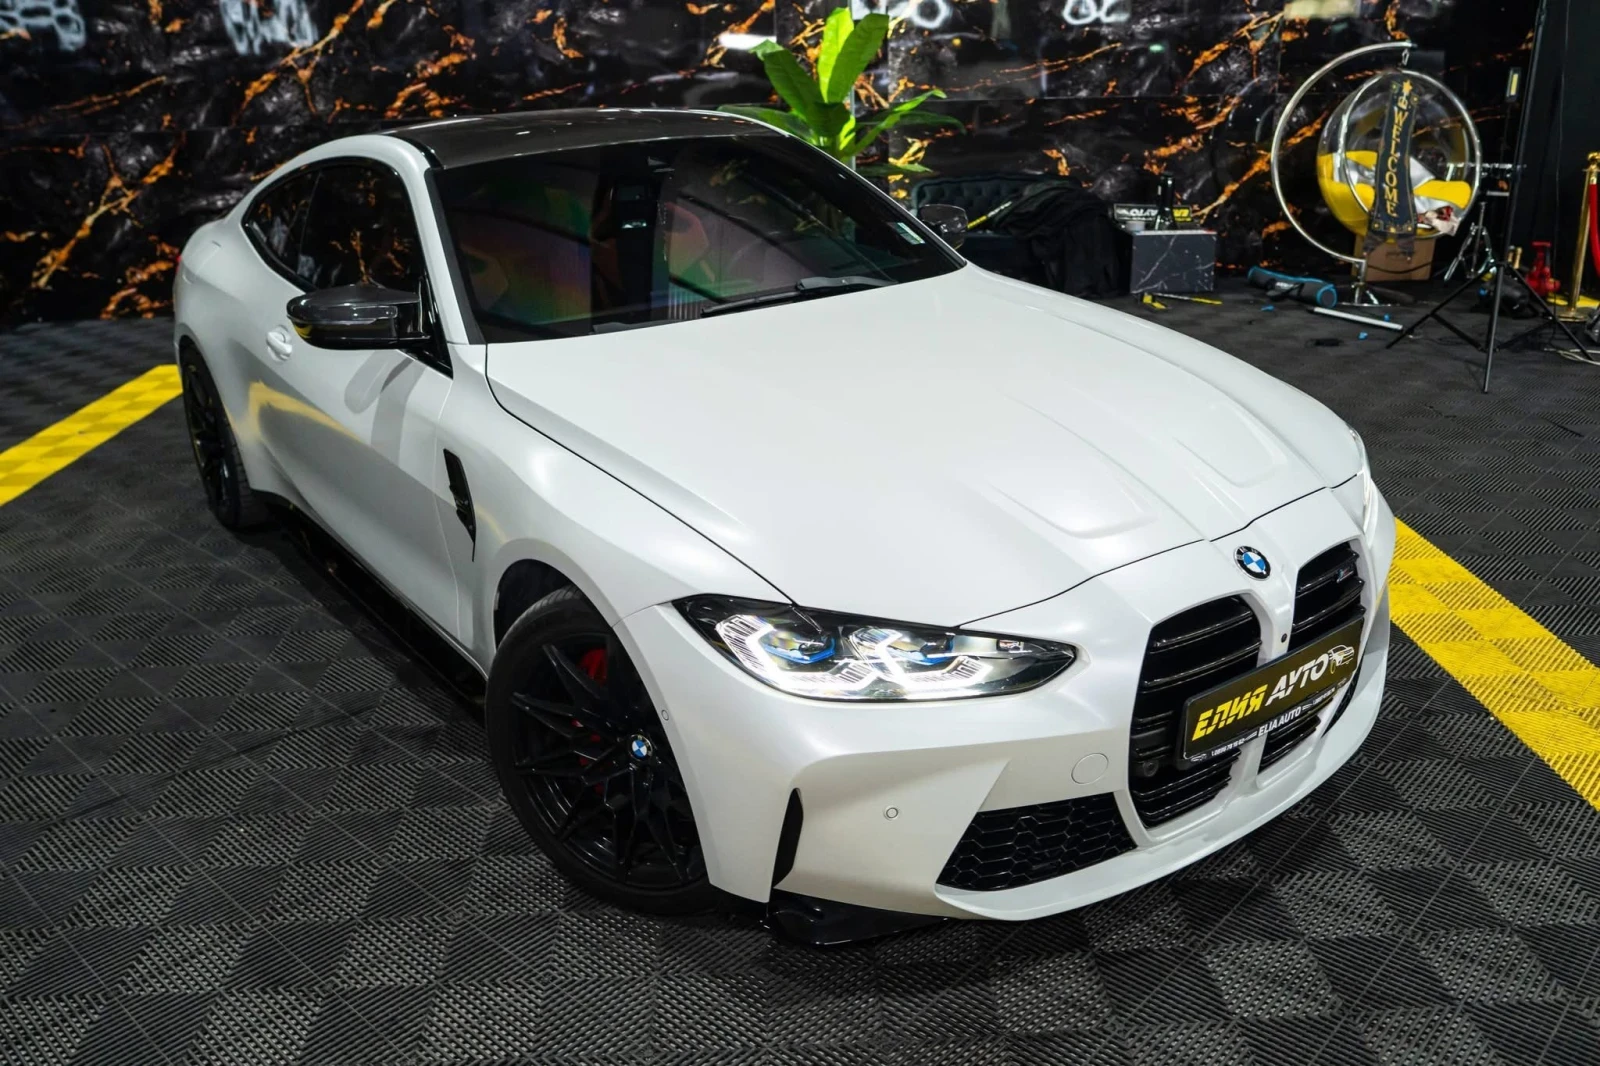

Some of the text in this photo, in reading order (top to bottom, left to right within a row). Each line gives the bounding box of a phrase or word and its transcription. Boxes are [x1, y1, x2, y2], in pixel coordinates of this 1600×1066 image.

[1384, 107, 1409, 217] WELCOME
[1258, 706, 1302, 737] ELIA AUTO
